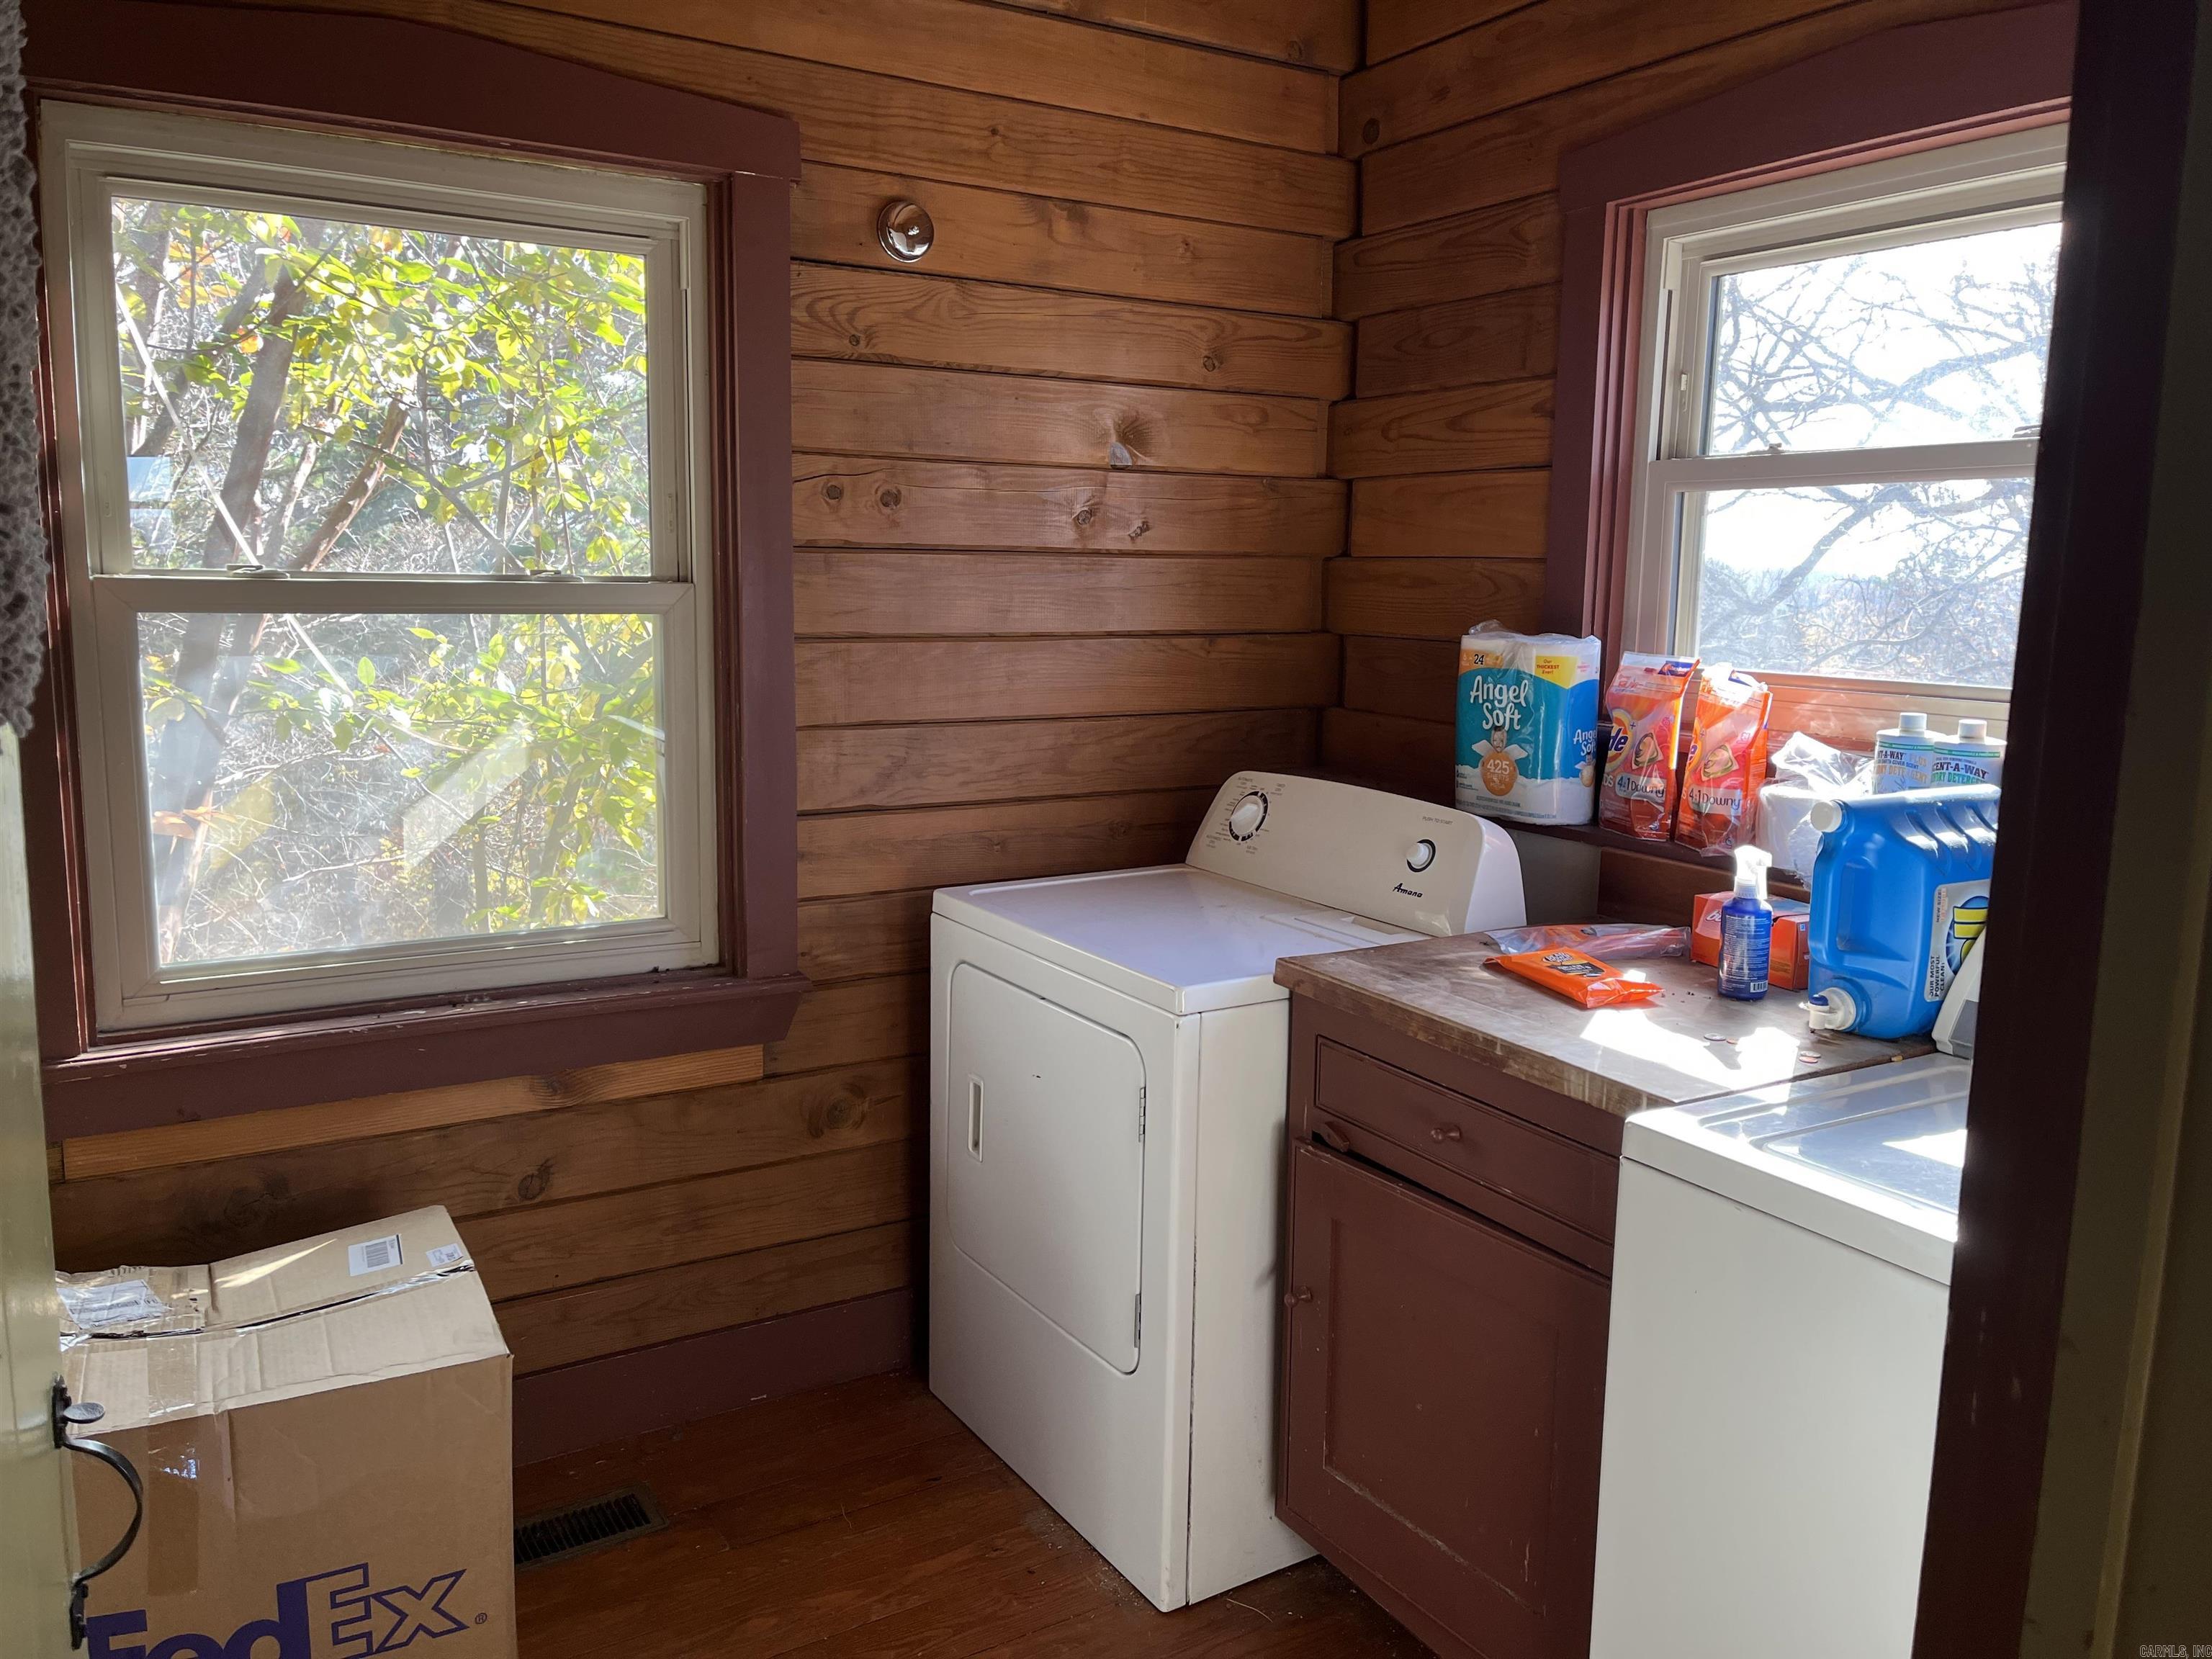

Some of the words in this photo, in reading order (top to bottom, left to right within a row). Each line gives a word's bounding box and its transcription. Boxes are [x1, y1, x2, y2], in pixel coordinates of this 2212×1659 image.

[1474, 654, 1485, 665] 24
[1470, 675, 1529, 707] Angel
[1483, 702, 1521, 732] Soft
[1573, 729, 1597, 745] Ange
[1609, 727, 1629, 752] de
[1878, 750, 1905, 760] T-A-WAY
[1487, 759, 1510, 775] 425
[1932, 761, 1987, 779] CENT-A-WAY
[1947, 771, 1987, 784] DETERG
[1702, 792, 1742, 811] Downy
[1393, 882, 1423, 898] Amana
